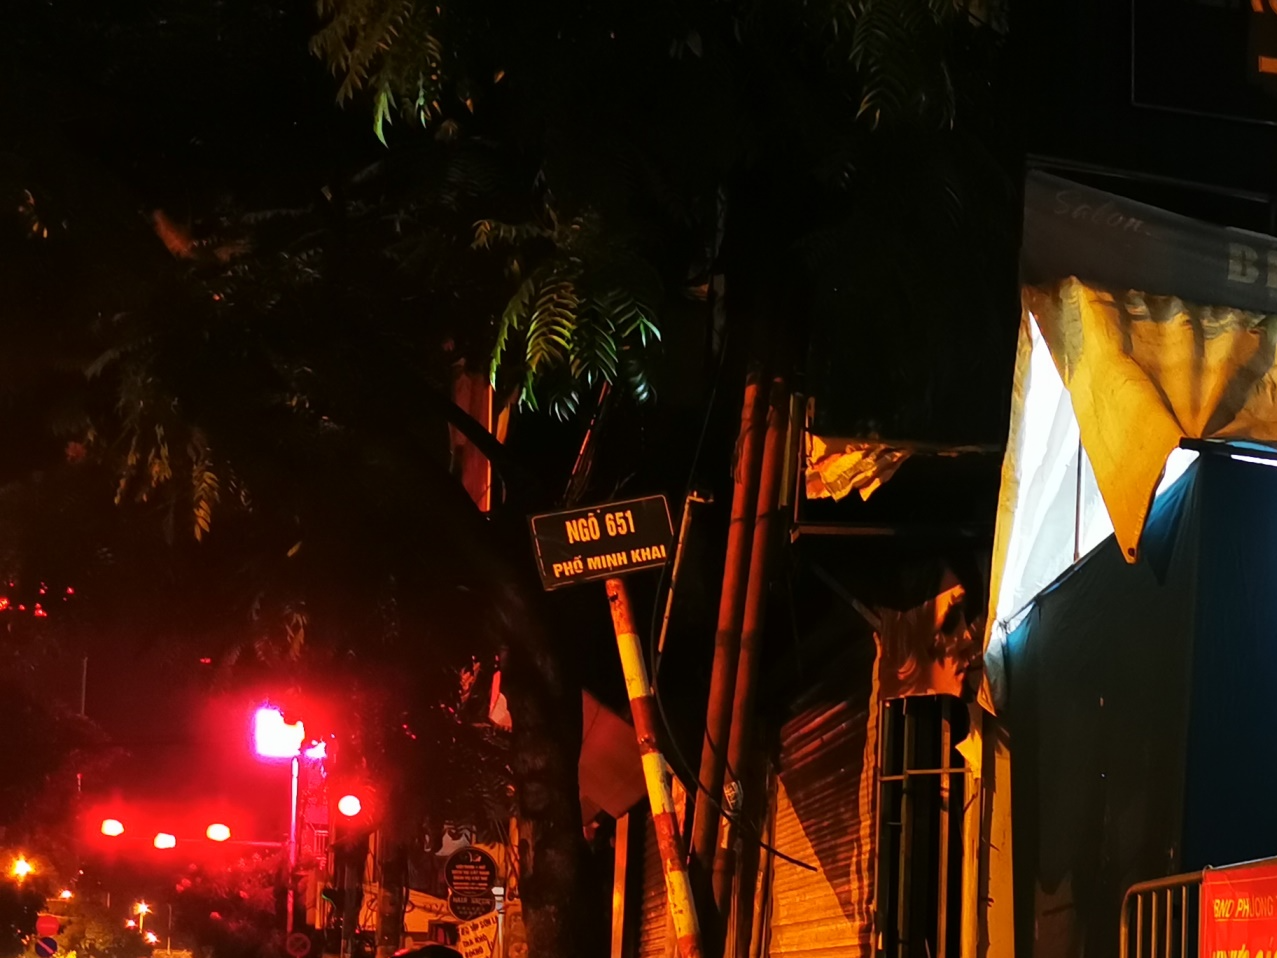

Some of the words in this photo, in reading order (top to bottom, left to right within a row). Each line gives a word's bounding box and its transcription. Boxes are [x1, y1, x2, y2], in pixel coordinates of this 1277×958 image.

[605, 510, 635, 537] 651
[552, 554, 584, 578] PHỐ
[587, 551, 628, 571] MINH
[631, 544, 667, 563] KHAI
